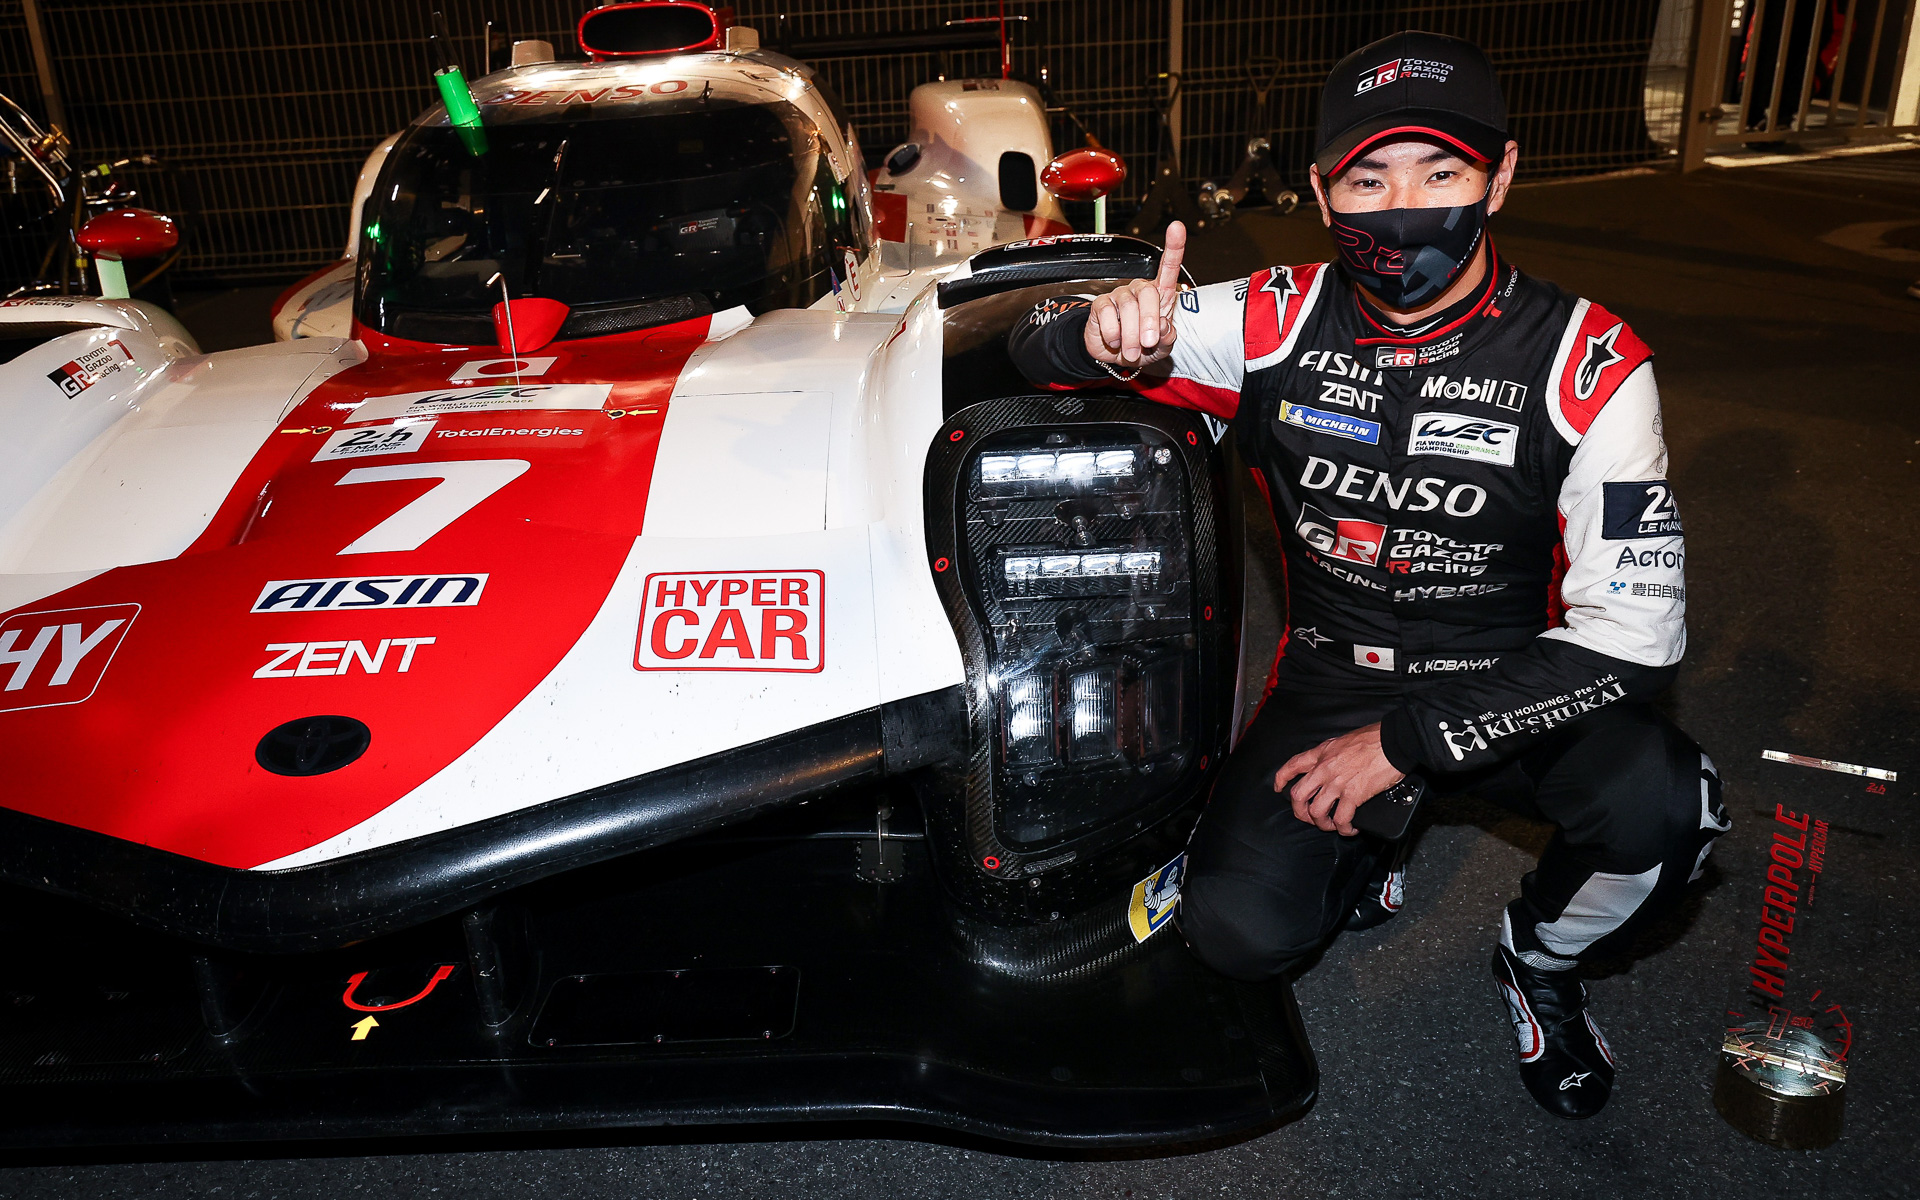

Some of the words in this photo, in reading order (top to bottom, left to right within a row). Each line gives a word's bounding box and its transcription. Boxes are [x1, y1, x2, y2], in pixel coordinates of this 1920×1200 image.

[1402, 64, 1449, 76] GAZOO
[1404, 58, 1454, 71] TOYOTA
[1356, 68, 1396, 93] GR
[1400, 71, 1447, 83] Racing
[483, 80, 689, 106] DENSO
[1418, 332, 1464, 352] TOYOTA
[1419, 340, 1460, 357] GAZOO
[76, 346, 108, 366] TOYOTA
[85, 354, 113, 373] GAZOO
[1377, 352, 1414, 367] GR
[1418, 346, 1460, 365] Racing
[60, 369, 95, 398] GR
[413, 386, 553, 405] WEC
[1420, 375, 1498, 404] Mobil
[1318, 380, 1384, 413] ZENT
[435, 426, 585, 439] TotalEnergies
[1305, 414, 1371, 437] MICHELIN
[1417, 419, 1511, 445] WEC
[1414, 446, 1470, 456] CHAMPIONSHIP
[1428, 440, 1455, 448] WORLD
[1455, 443, 1501, 456] ENDURANCE
[1299, 455, 1488, 518] DENSO
[335, 459, 531, 556] 7
[1637, 522, 1659, 534] LE
[1659, 521, 1684, 533] MAN
[1298, 520, 1378, 564] GR
[1388, 559, 1488, 577] Racing
[256, 577, 480, 610] AISIN
[654, 578, 810, 608] HYPER
[650, 608, 810, 661] CAR
[0, 618, 126, 692] HY
[252, 636, 437, 679] ZENT
[1407, 661, 1422, 674] K.
[1574, 686, 1596, 699] Pte.
[1595, 673, 1618, 687] Ltd.
[1808, 819, 1830, 874] HYPERCAR
[1749, 803, 1810, 998] HYPERPOLE
